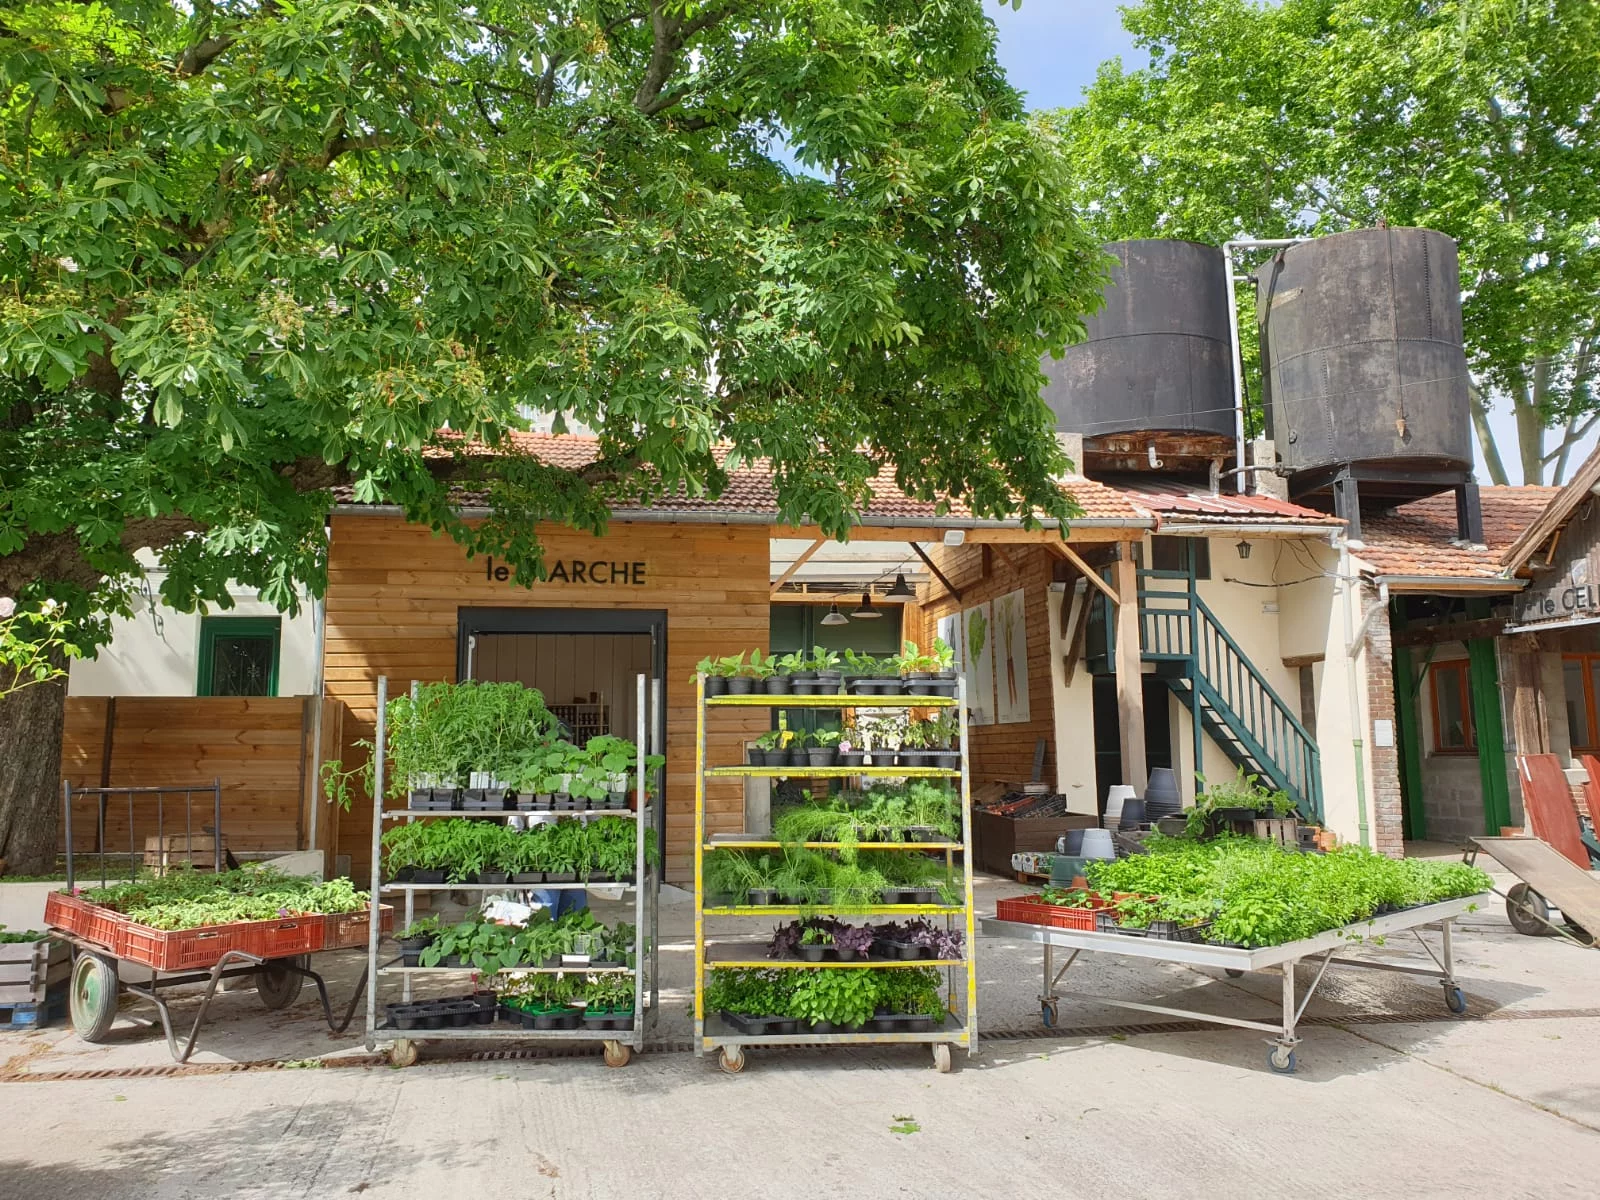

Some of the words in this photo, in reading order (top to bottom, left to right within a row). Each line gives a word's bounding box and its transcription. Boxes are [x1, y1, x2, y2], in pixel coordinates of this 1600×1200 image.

[487, 555, 509, 582] le
[517, 559, 646, 585] ARCHE
[1540, 592, 1555, 615] le
[1562, 584, 1600, 611] CEL
